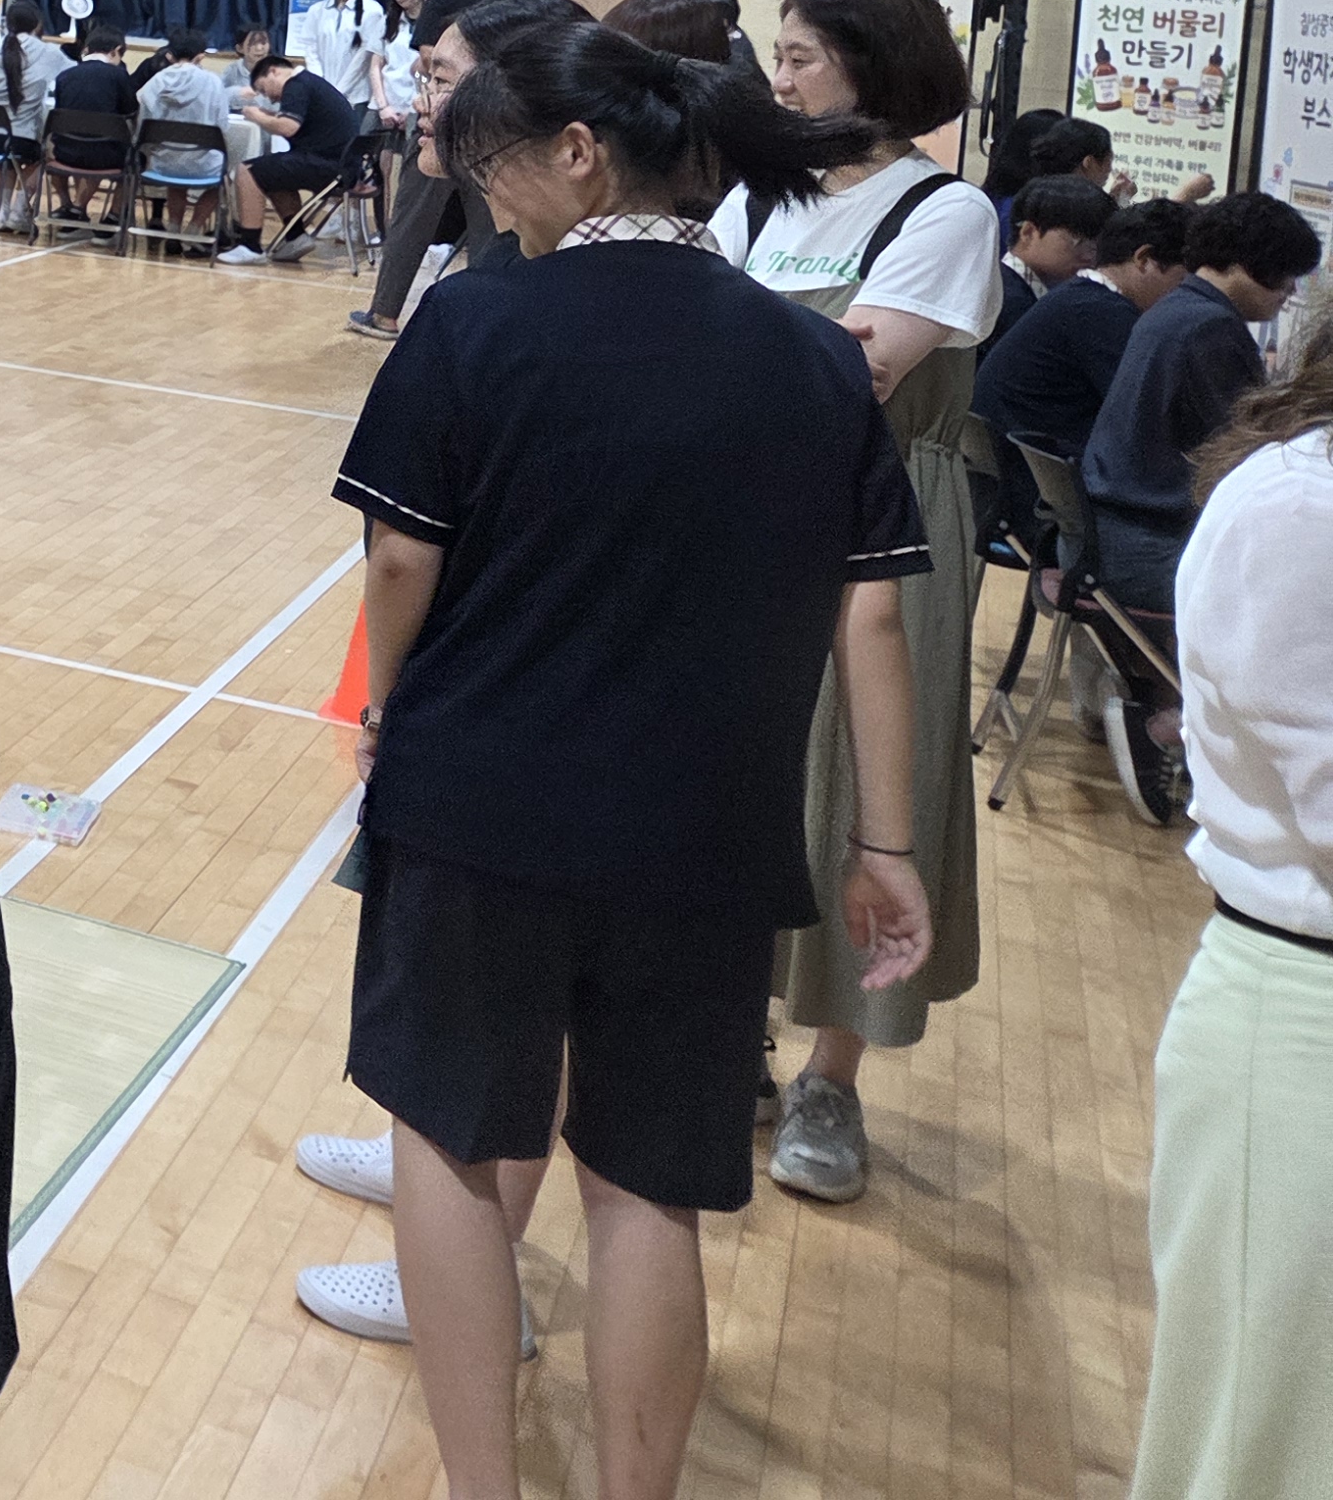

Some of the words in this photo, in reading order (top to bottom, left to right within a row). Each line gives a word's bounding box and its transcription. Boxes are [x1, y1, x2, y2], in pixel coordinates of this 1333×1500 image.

[1097, 4, 1145, 33] 천연
[1153, 9, 1225, 39] 버물리
[1122, 39, 1193, 70] 만들기
[1283, 47, 1333, 85] 학생자
[1301, 97, 1332, 130] 부스
